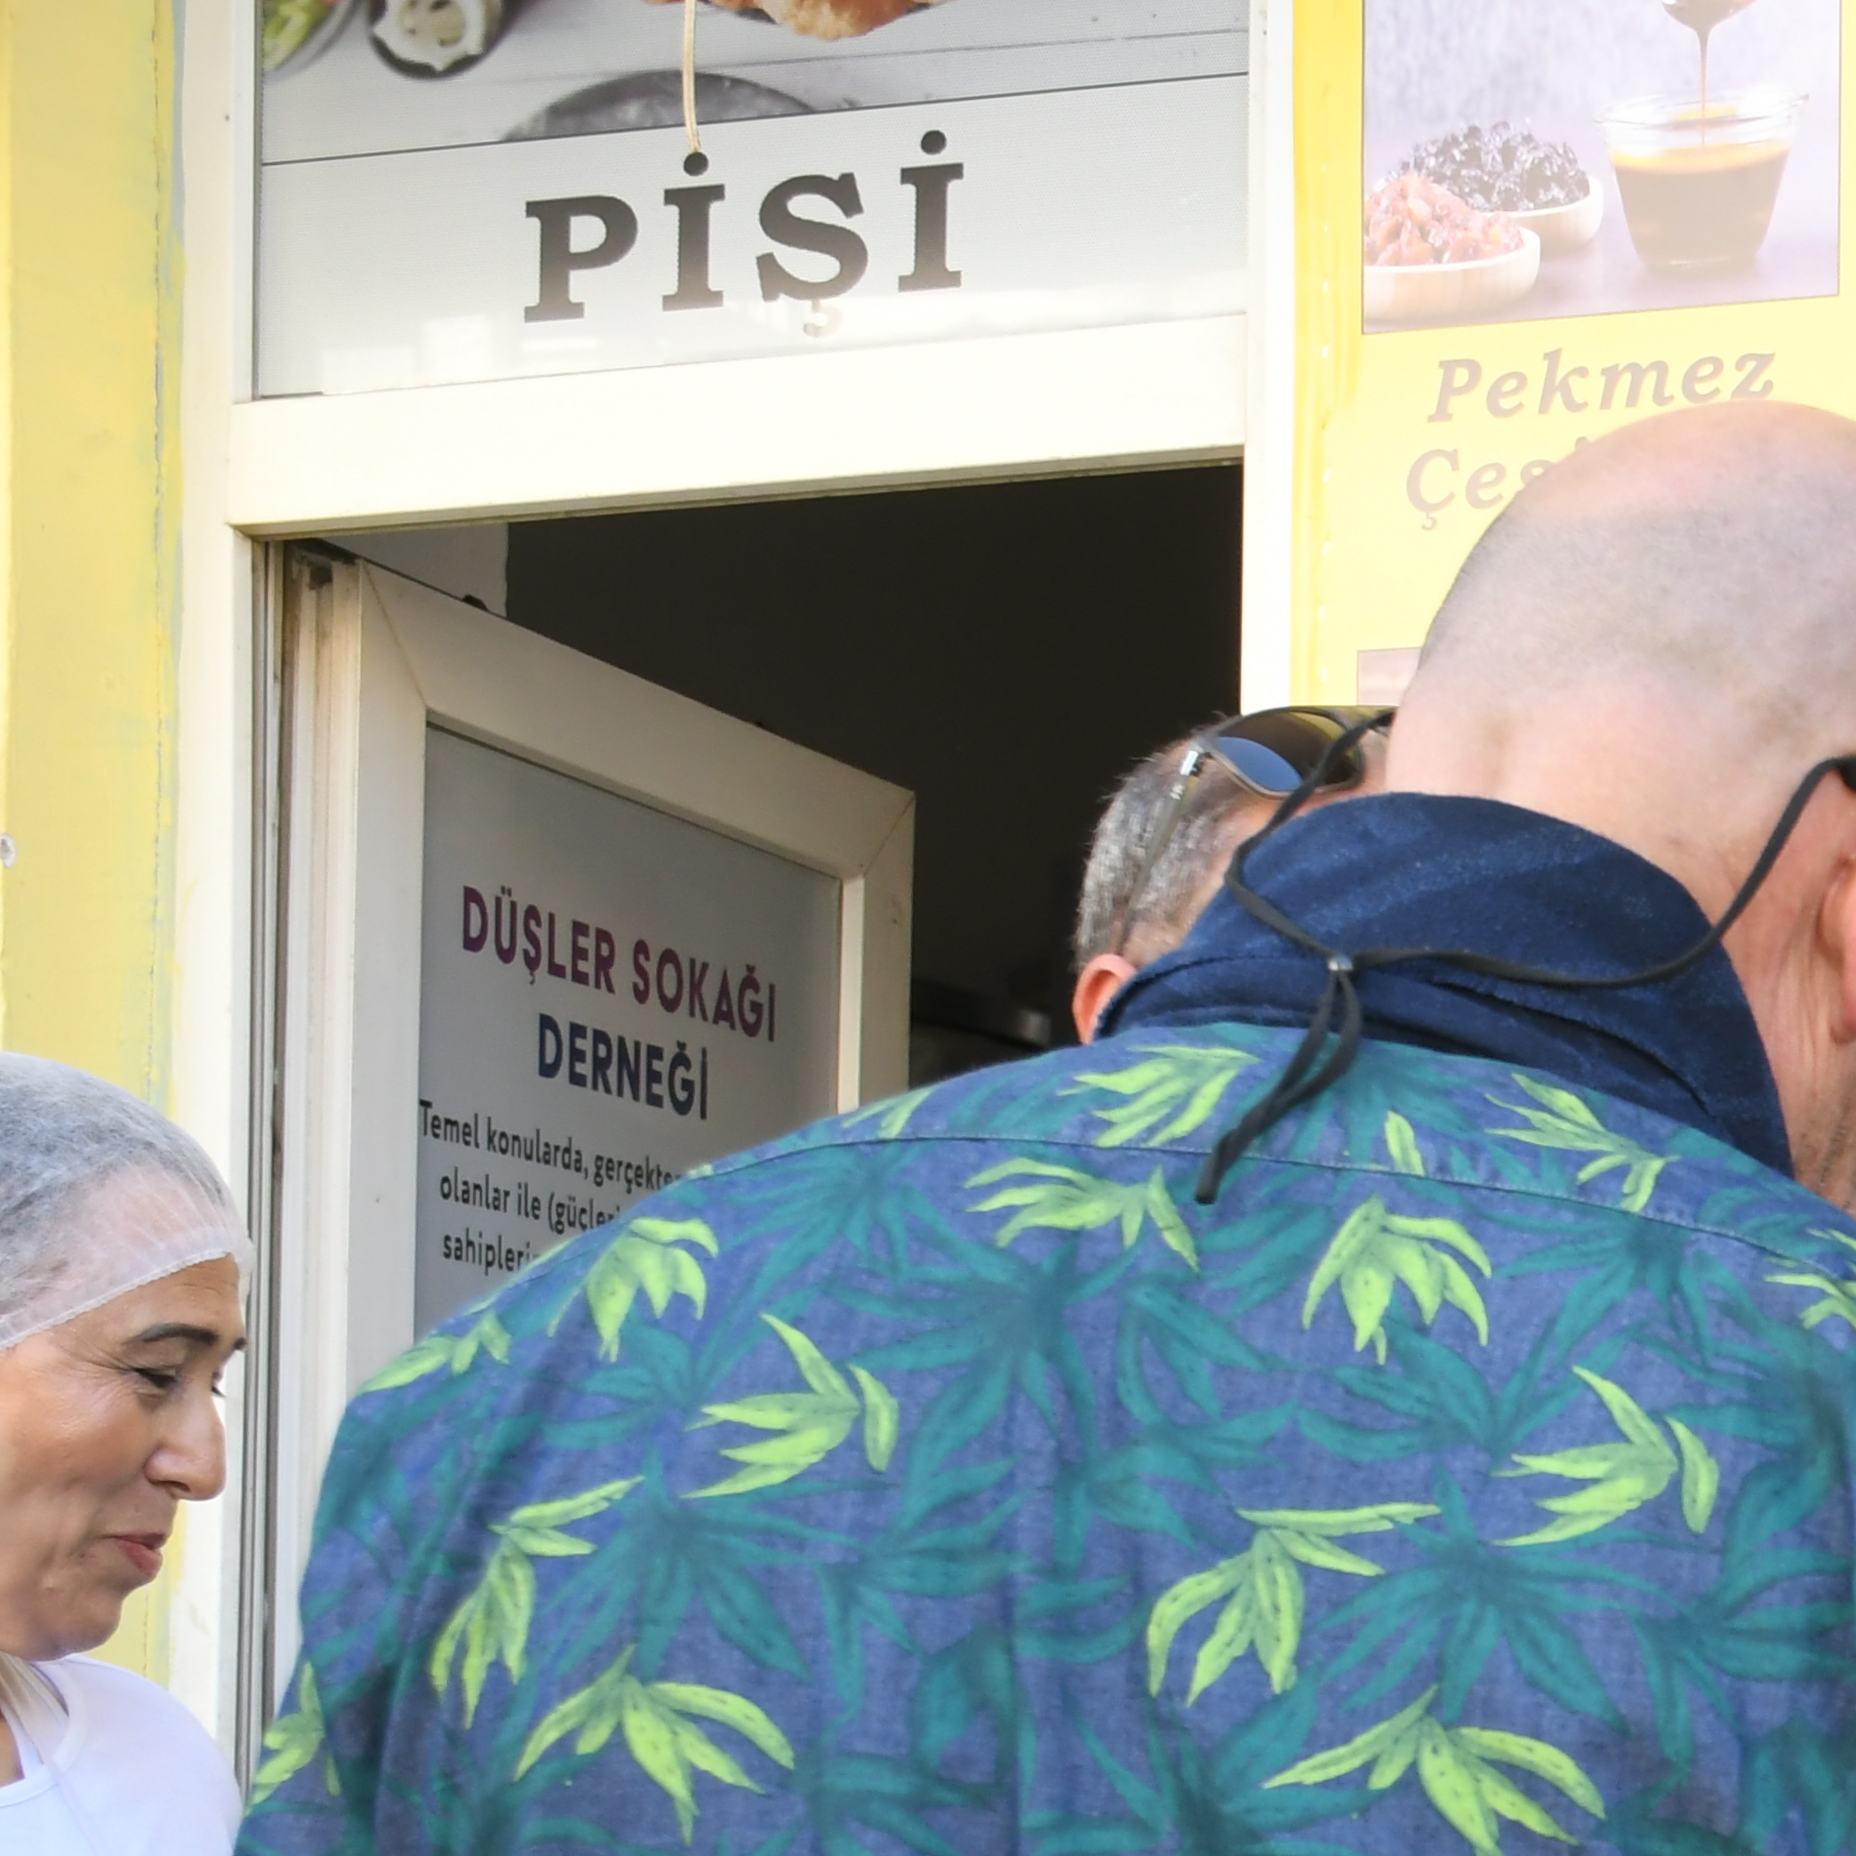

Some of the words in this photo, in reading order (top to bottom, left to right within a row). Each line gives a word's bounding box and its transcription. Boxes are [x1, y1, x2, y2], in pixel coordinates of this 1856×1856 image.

[1427, 347, 1777, 424] Pekmez
[462, 885, 615, 994] DÜŞLER
[631, 938, 776, 1042] SOKAĞI
[538, 1012, 708, 1120] DERNEĞİ
[419, 1099, 480, 1149] Temel
[487, 1116, 589, 1181] konularda,
[594, 1155, 681, 1195] gerçekte
[440, 1166, 510, 1214] olanlar
[517, 1182, 542, 1220] ile
[442, 1227, 541, 1277] sahipleri
